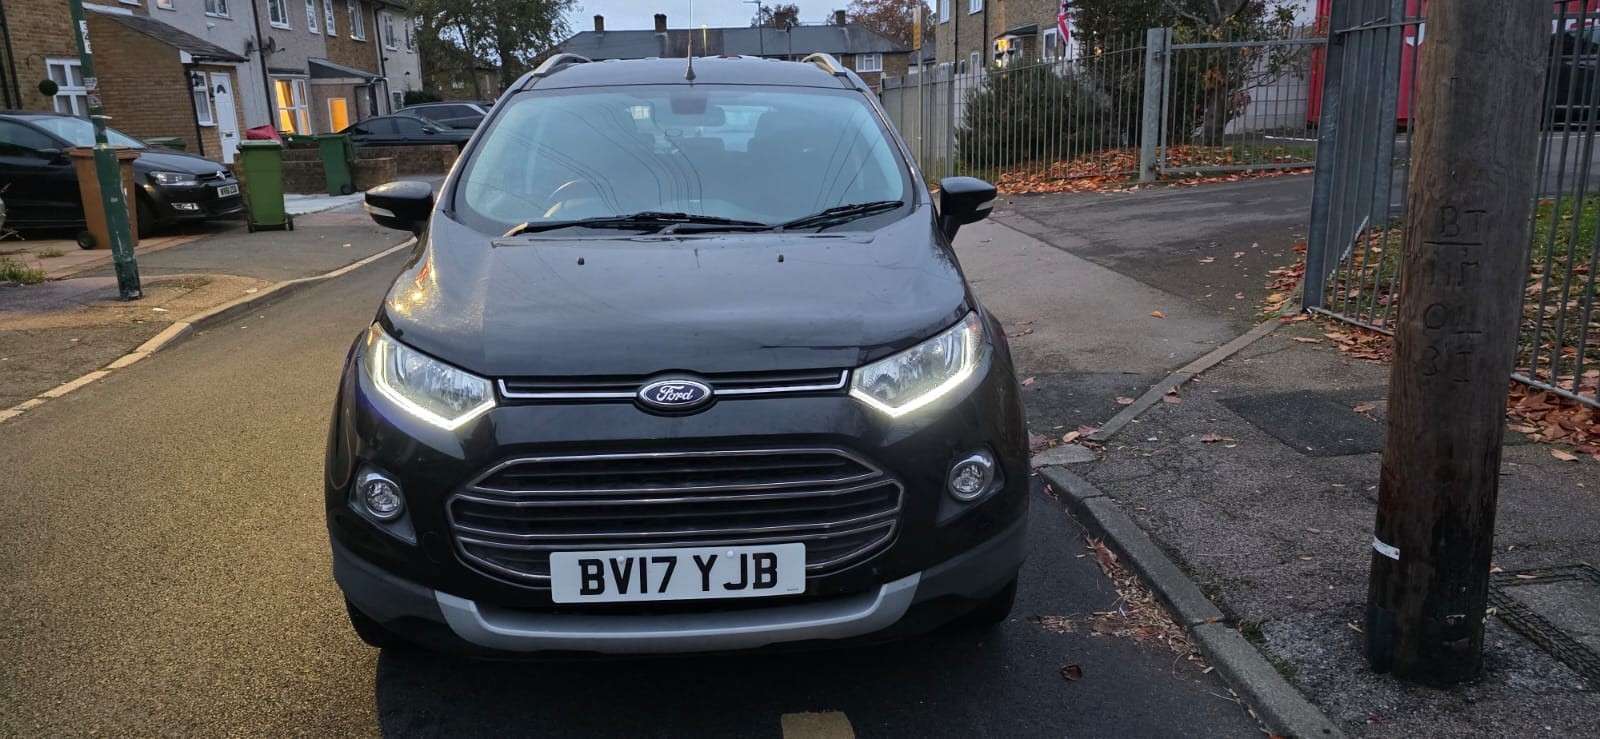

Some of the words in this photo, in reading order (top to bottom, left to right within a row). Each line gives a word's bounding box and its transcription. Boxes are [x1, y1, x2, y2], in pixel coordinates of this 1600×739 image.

[1439, 205, 1487, 237] BT
[656, 385, 694, 401] Ford
[578, 556, 677, 595] BV17
[693, 552, 778, 591] YJB
